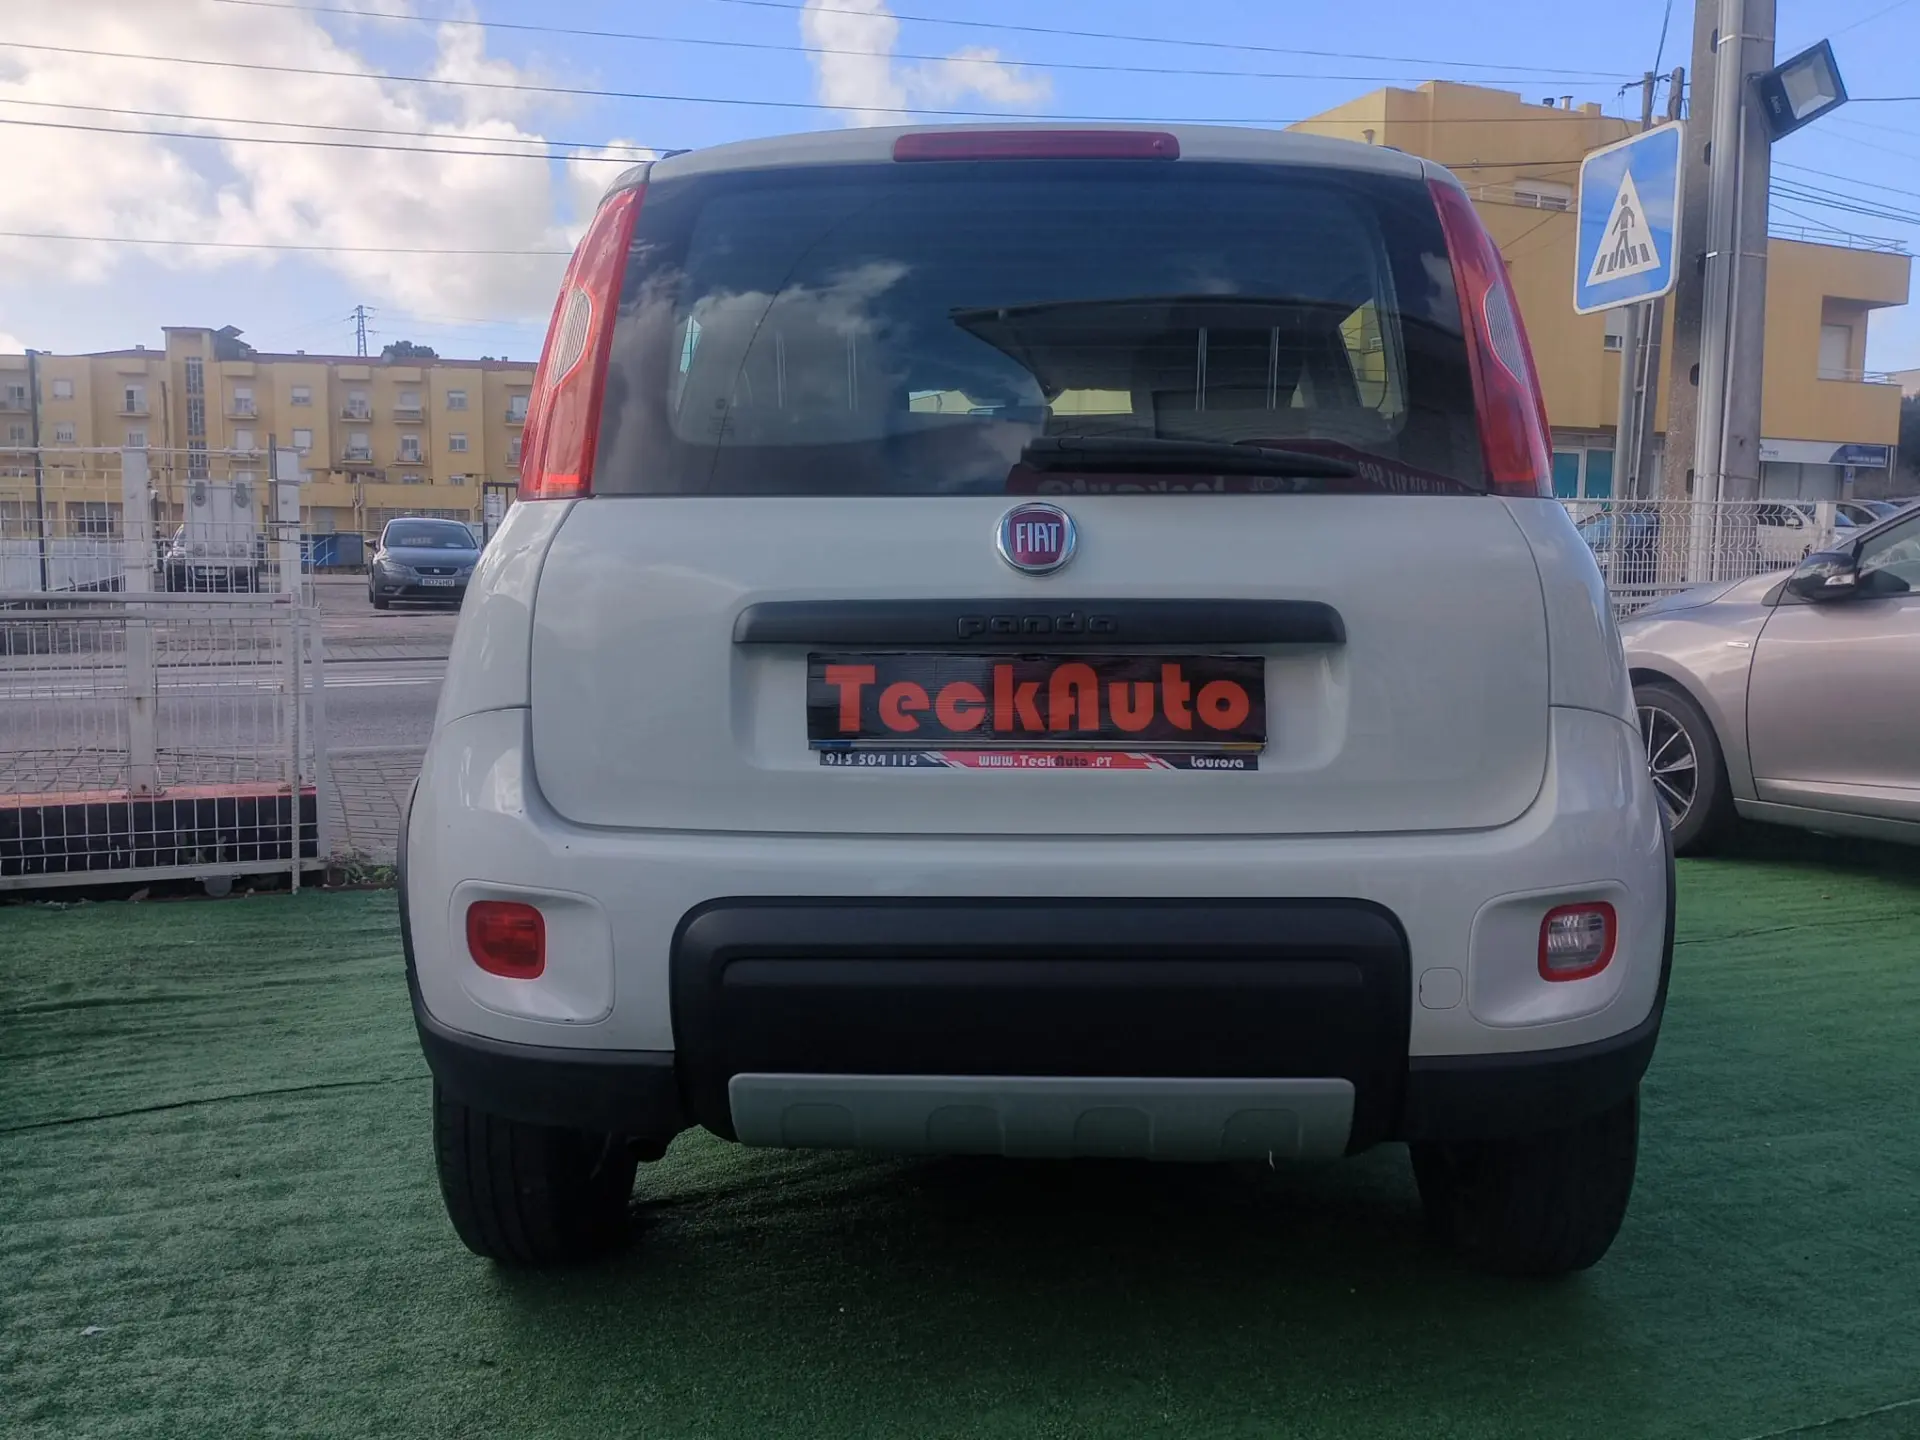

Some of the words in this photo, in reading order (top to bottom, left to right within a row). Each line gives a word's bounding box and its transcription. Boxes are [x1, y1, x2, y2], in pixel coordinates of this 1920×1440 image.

[1016, 522, 1061, 553] FIAT
[825, 662, 1250, 733] TeckAuto
[826, 752, 852, 767] 915
[858, 753, 886, 767] 504
[892, 754, 918, 768] 115
